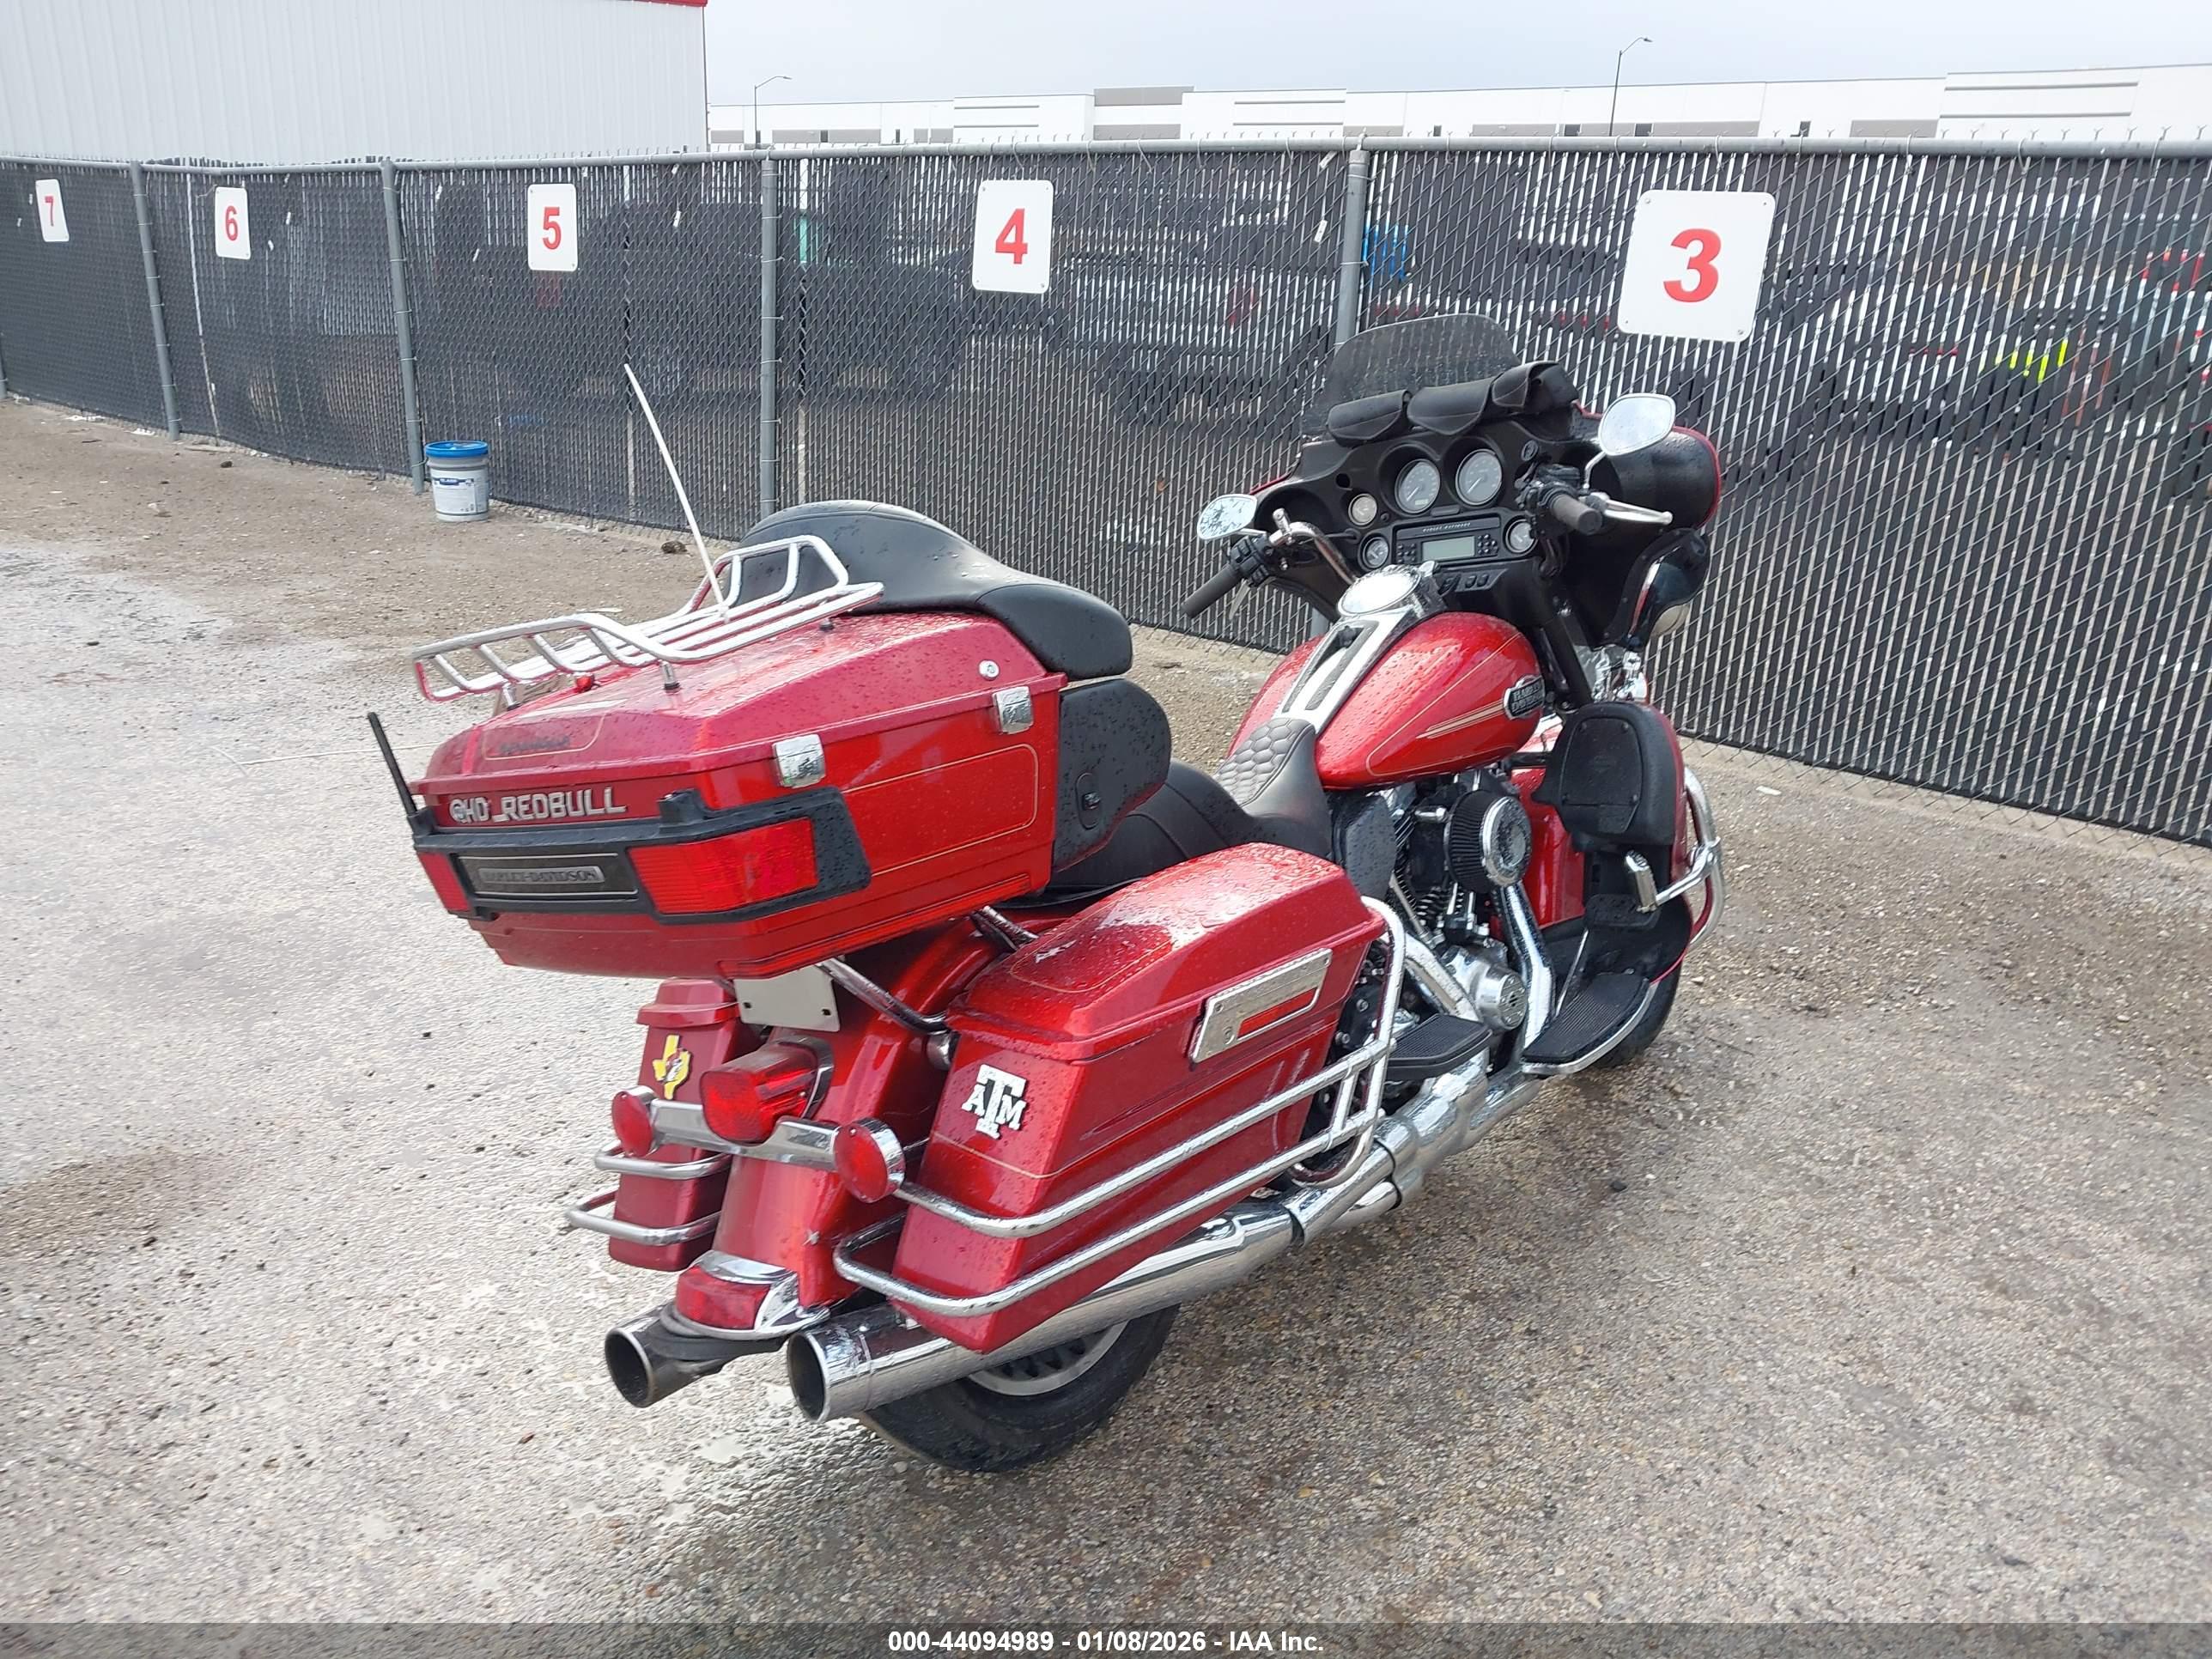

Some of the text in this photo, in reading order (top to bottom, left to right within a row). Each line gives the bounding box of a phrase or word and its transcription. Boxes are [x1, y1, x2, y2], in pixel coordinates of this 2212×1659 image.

[46, 196, 53, 227] 7
[225, 205, 239, 241] 6
[542, 207, 562, 251] 5
[995, 208, 1028, 264] 4
[1664, 228, 1722, 303] 3
